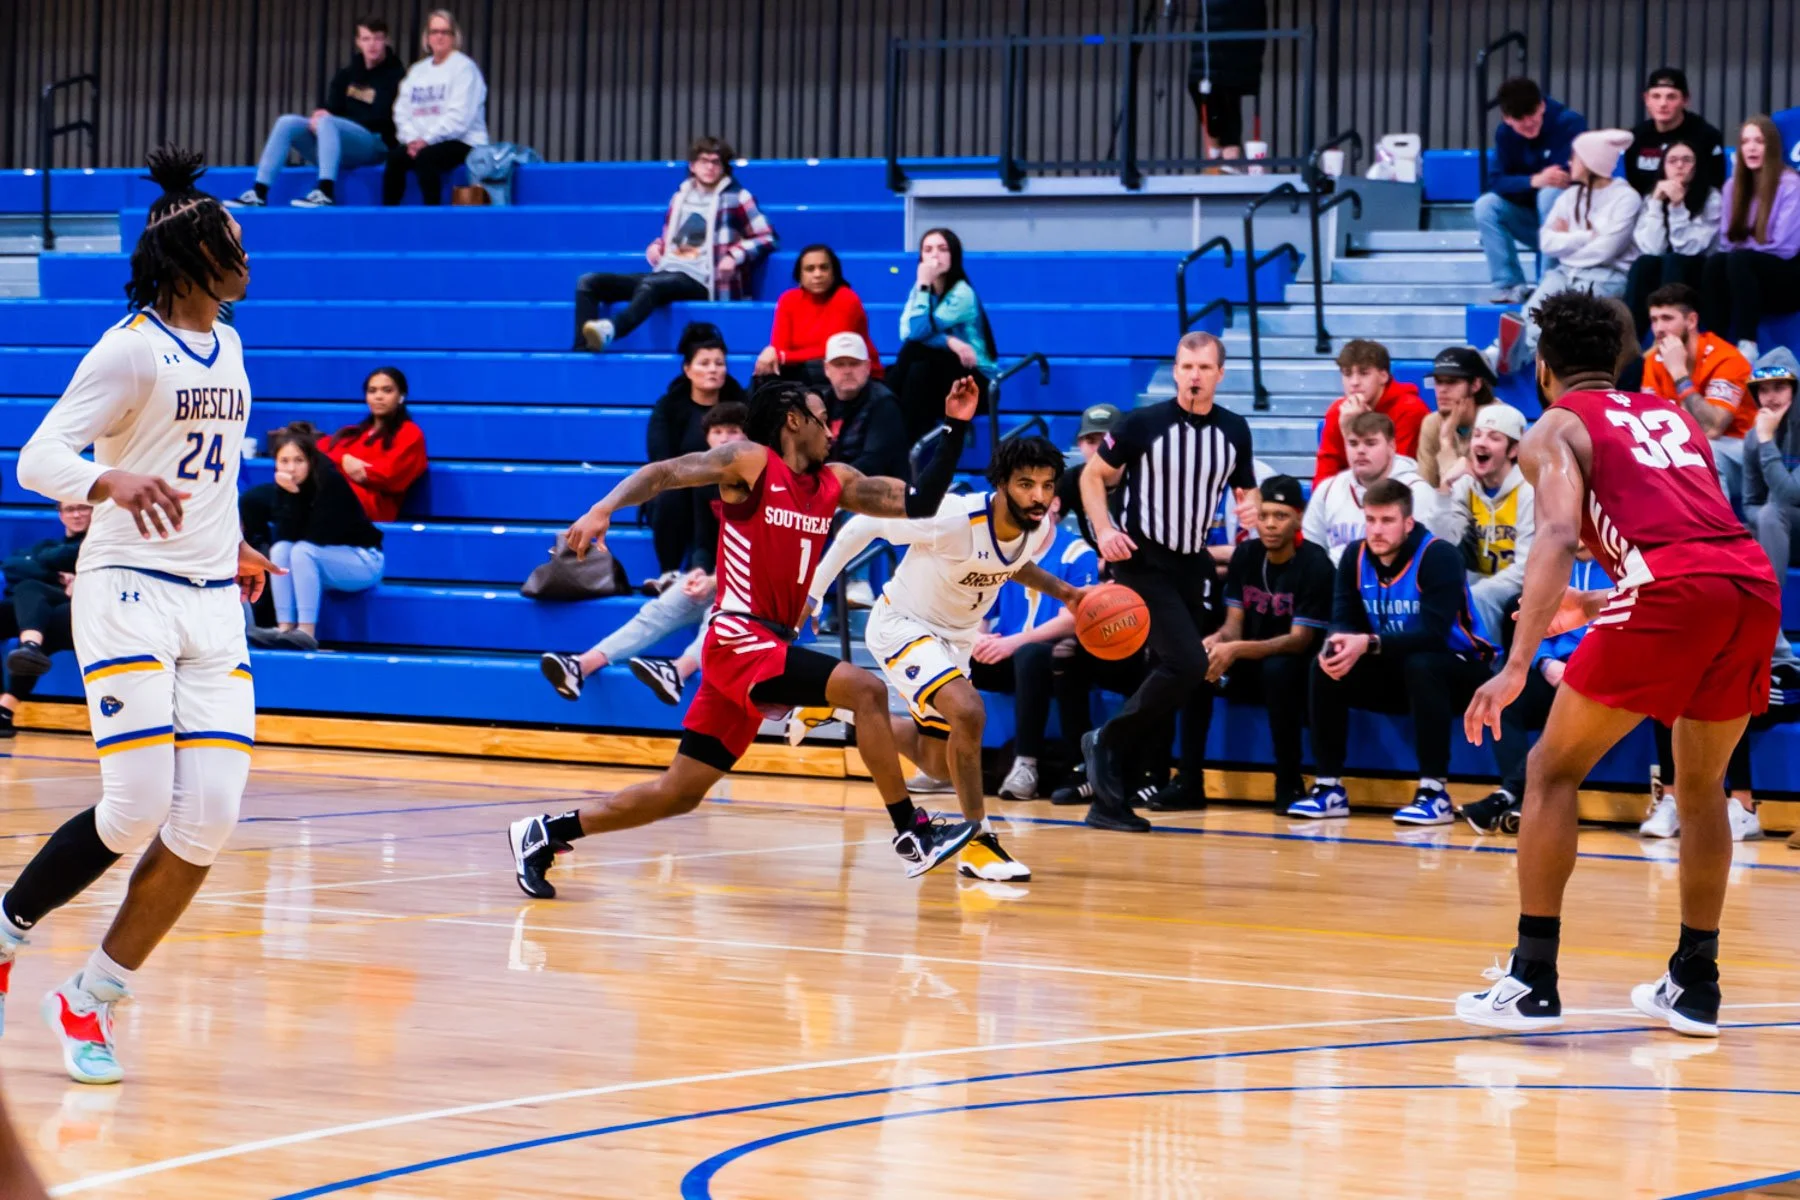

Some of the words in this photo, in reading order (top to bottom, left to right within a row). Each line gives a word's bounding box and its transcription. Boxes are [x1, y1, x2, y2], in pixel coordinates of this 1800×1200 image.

[174, 387, 244, 421] BRESCIA
[177, 432, 225, 483] 24
[1604, 409, 1708, 470] 32
[797, 538, 812, 586] 1
